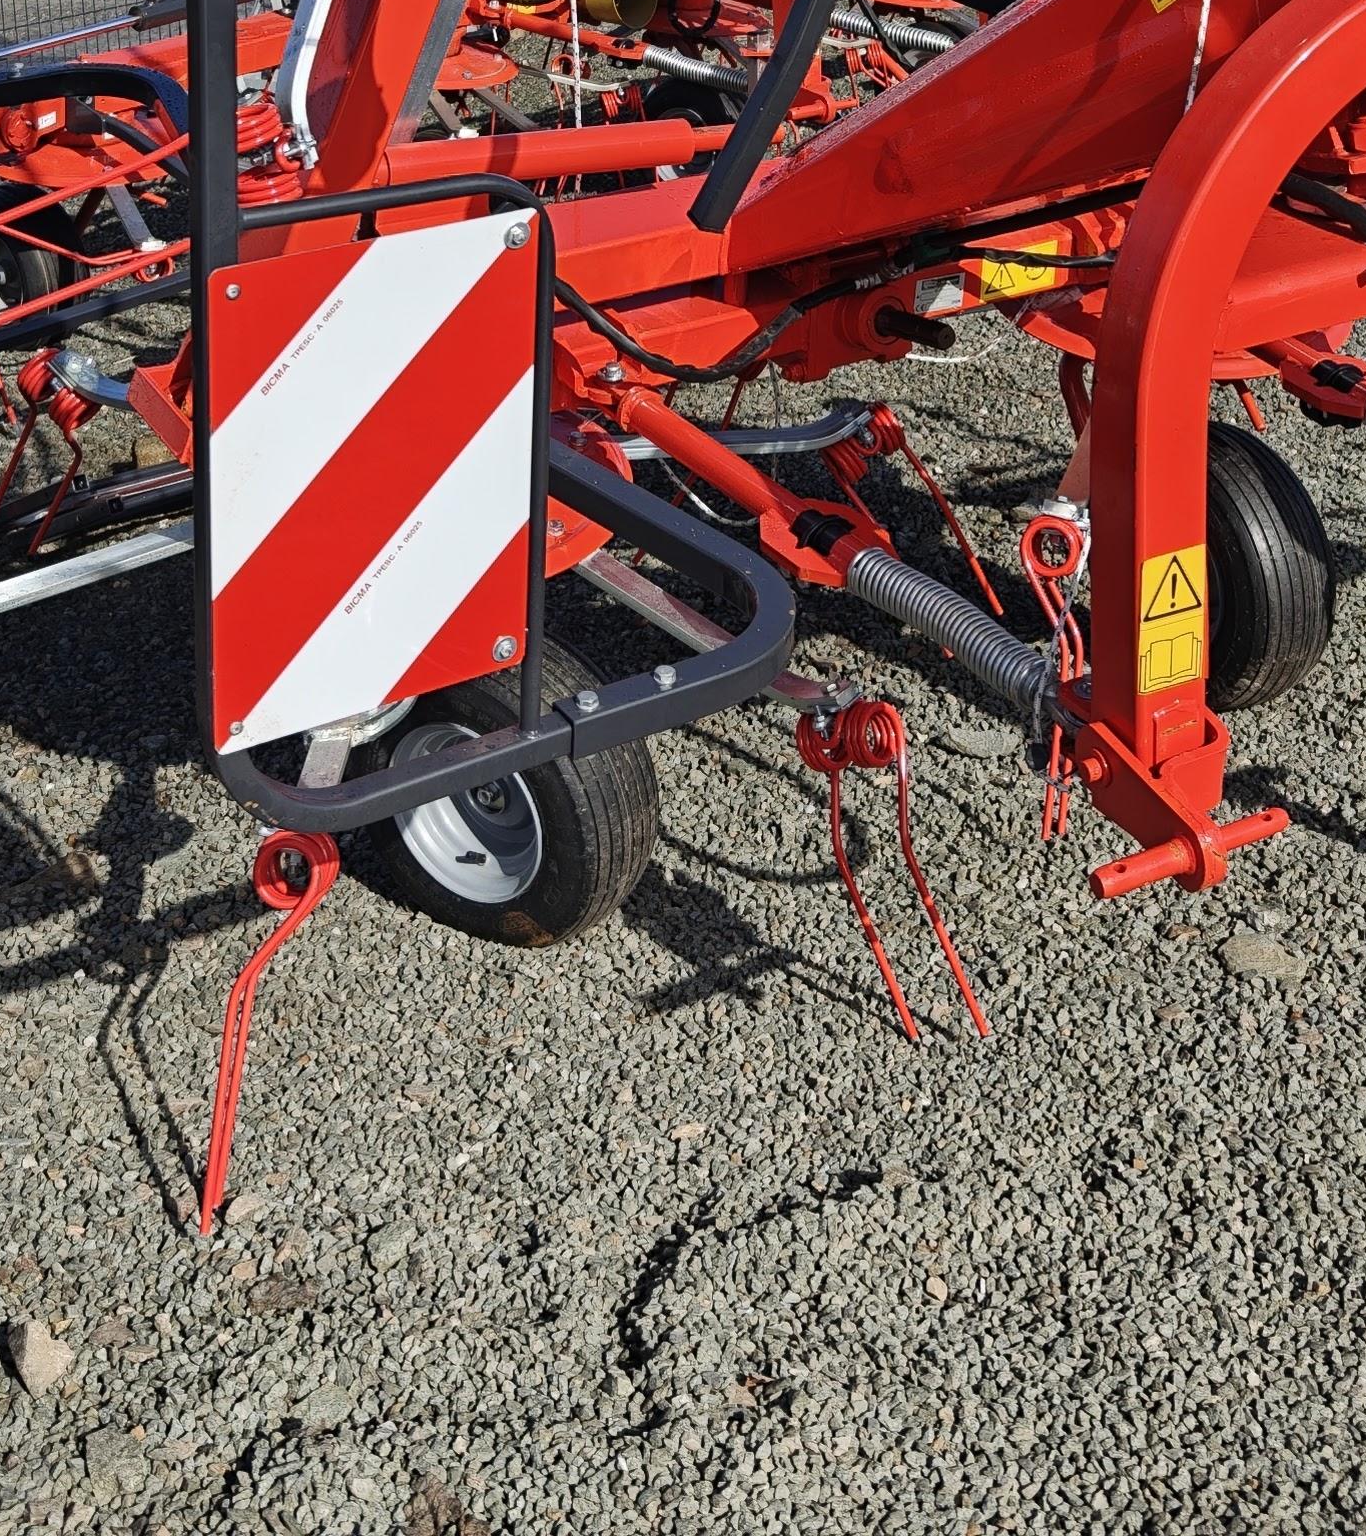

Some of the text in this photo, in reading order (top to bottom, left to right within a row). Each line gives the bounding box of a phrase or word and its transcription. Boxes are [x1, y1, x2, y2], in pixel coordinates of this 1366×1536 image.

[260, 362, 291, 396] BICMA
[322, 298, 344, 322] 06025
[344, 582, 372, 615] BICMA
[403, 520, 423, 543] 06025
